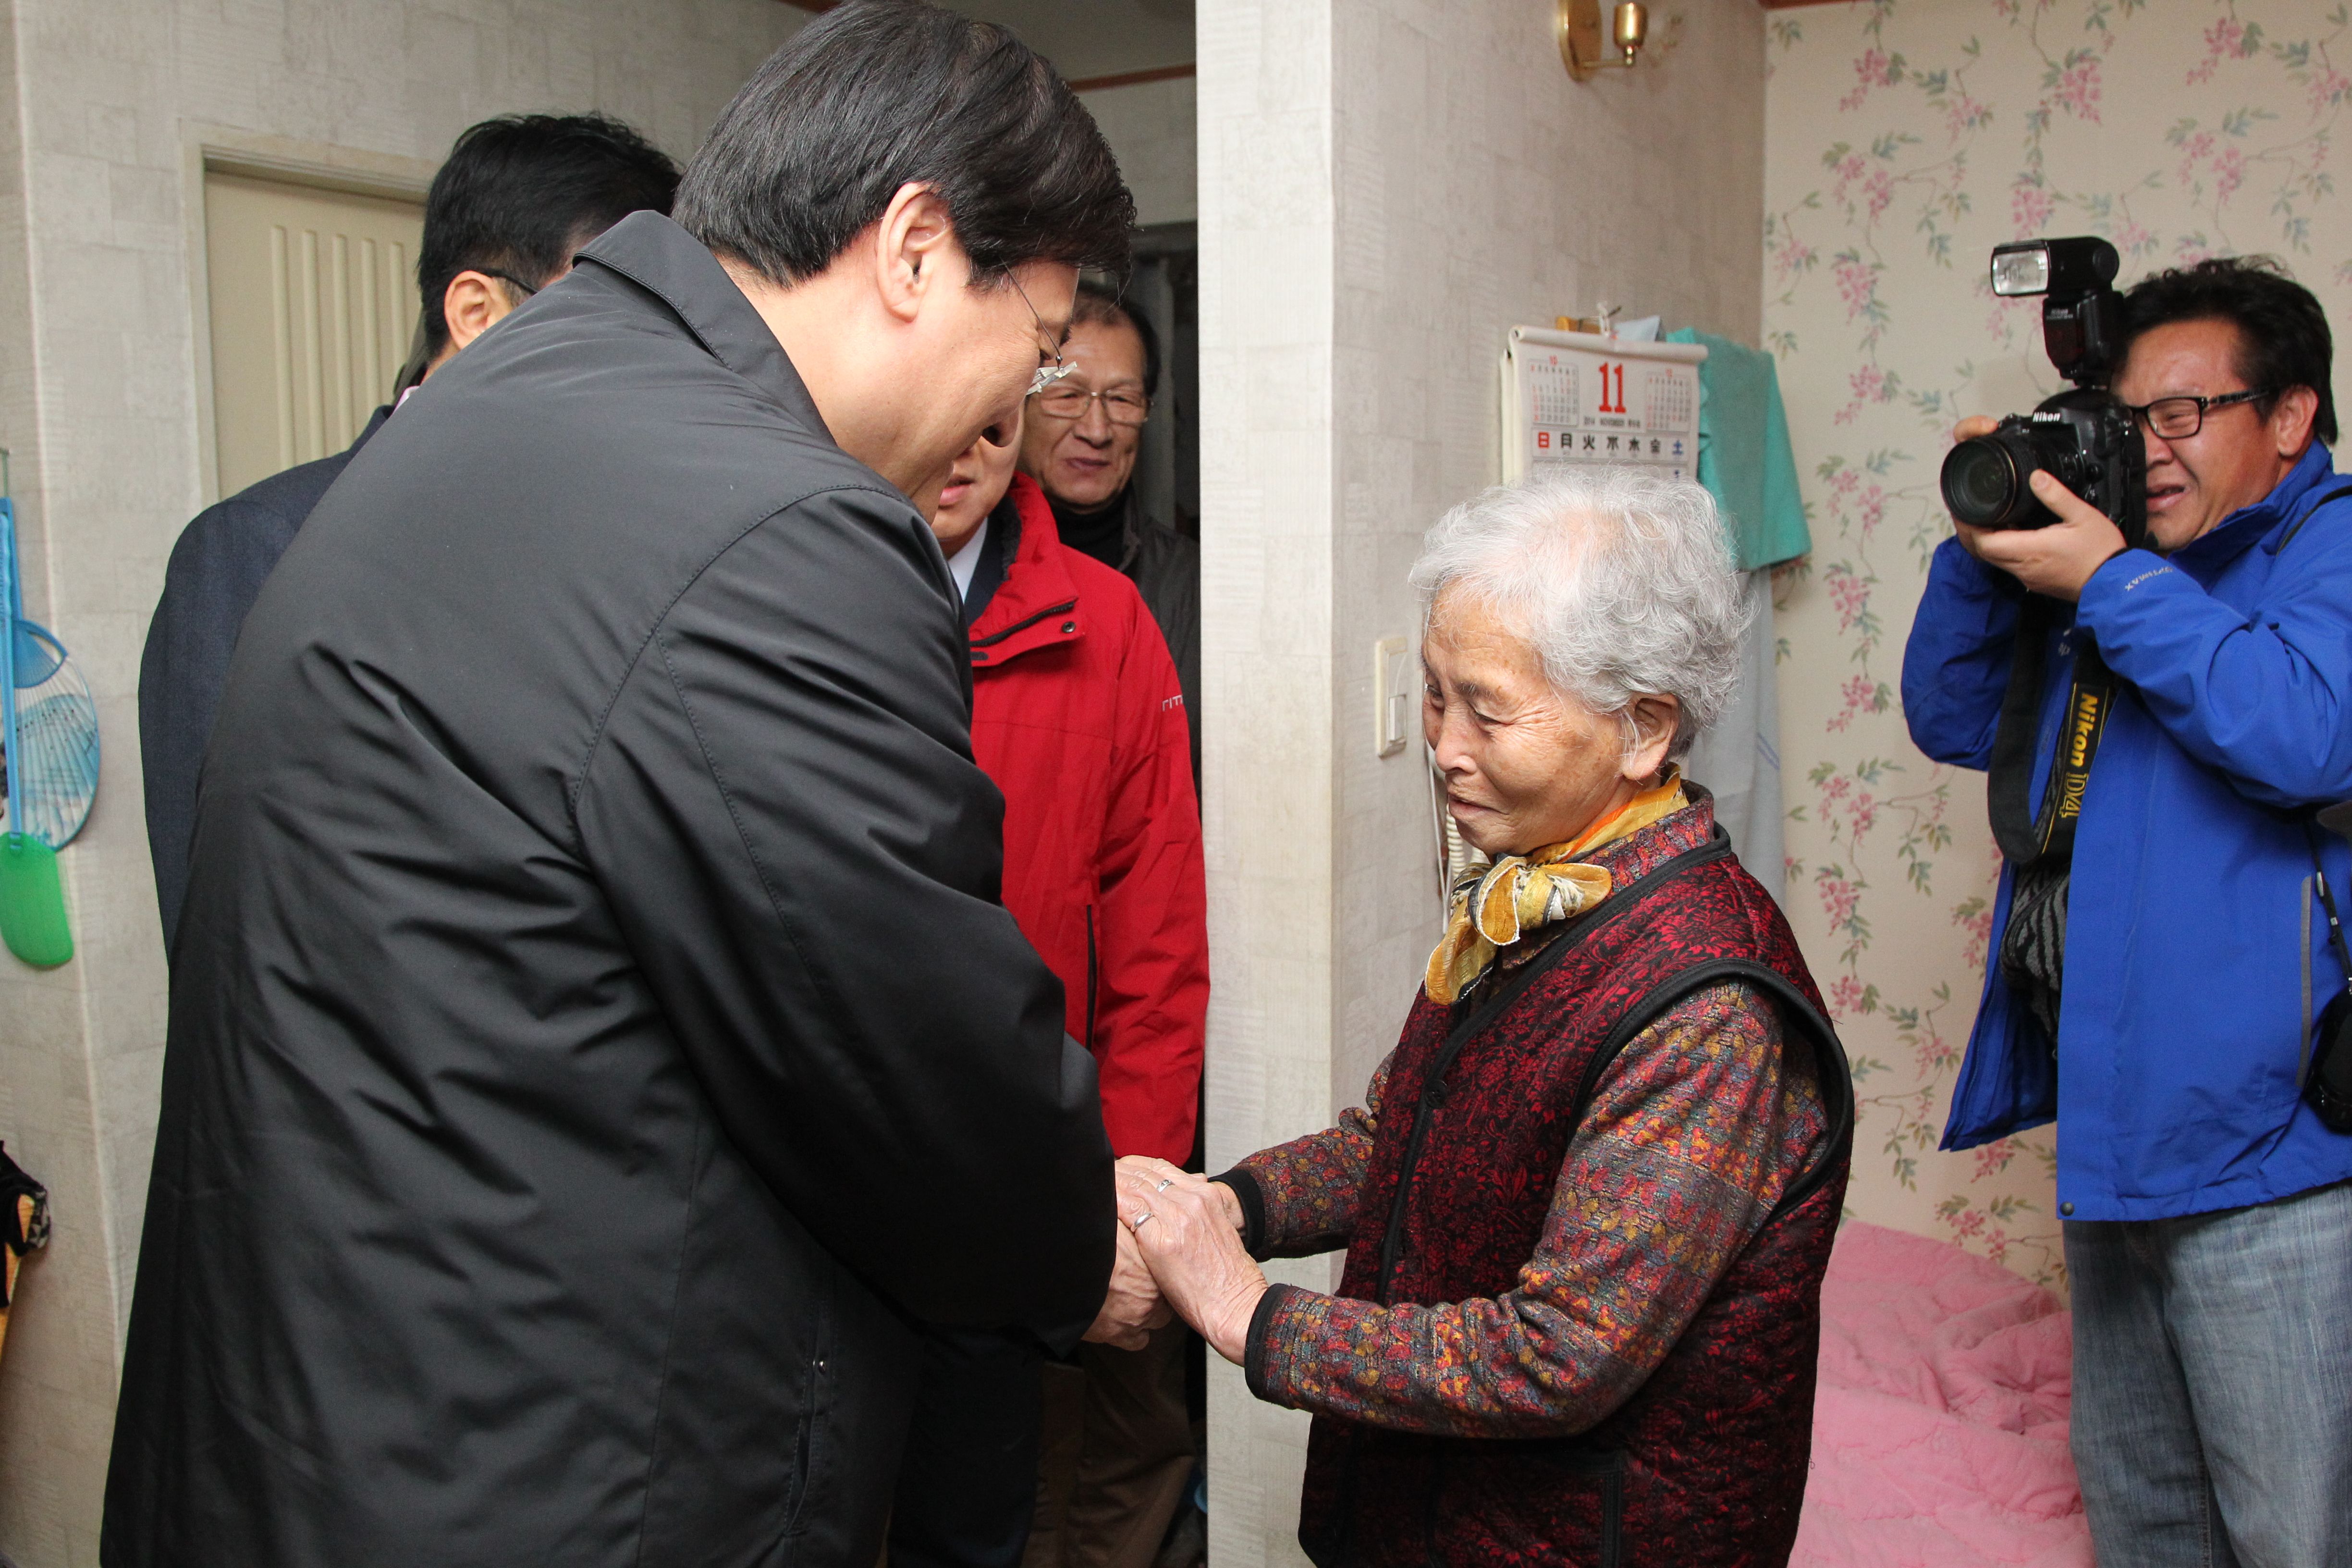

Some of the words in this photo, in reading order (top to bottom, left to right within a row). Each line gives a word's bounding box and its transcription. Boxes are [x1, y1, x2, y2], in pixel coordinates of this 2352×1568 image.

[1599, 361, 1626, 414] 11
[2033, 411, 2060, 422] Nikon
[1538, 431, 1549, 448] 日
[1583, 435, 1595, 450] 火
[1673, 439, 1684, 455] 土
[2070, 693, 2098, 767] Nikon
